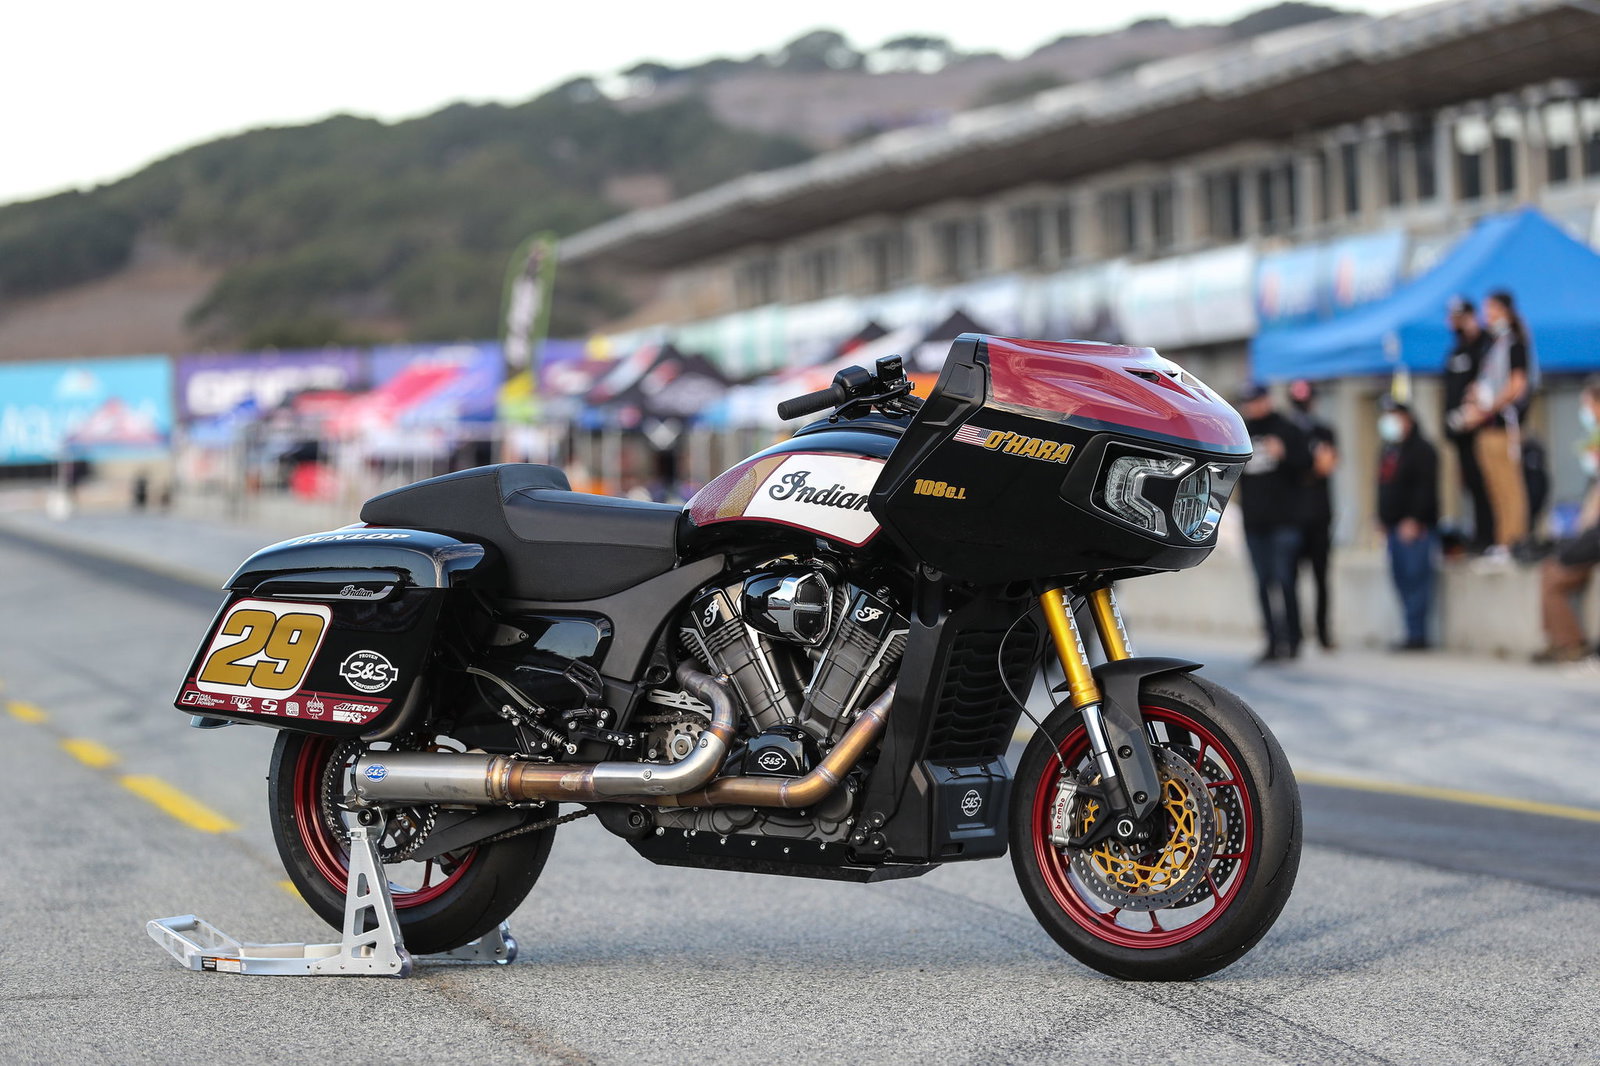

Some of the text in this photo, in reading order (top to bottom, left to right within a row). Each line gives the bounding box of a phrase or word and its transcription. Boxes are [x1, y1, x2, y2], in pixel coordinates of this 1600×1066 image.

[984, 430, 1075, 464] O'HARA
[768, 470, 871, 512] Indian
[340, 585, 374, 597] Indian
[200, 609, 325, 690] 29
[367, 768, 385, 776] S&S
[763, 757, 780, 765] S&S
[963, 797, 979, 808] S&S
[1056, 797, 1065, 829] brembo
